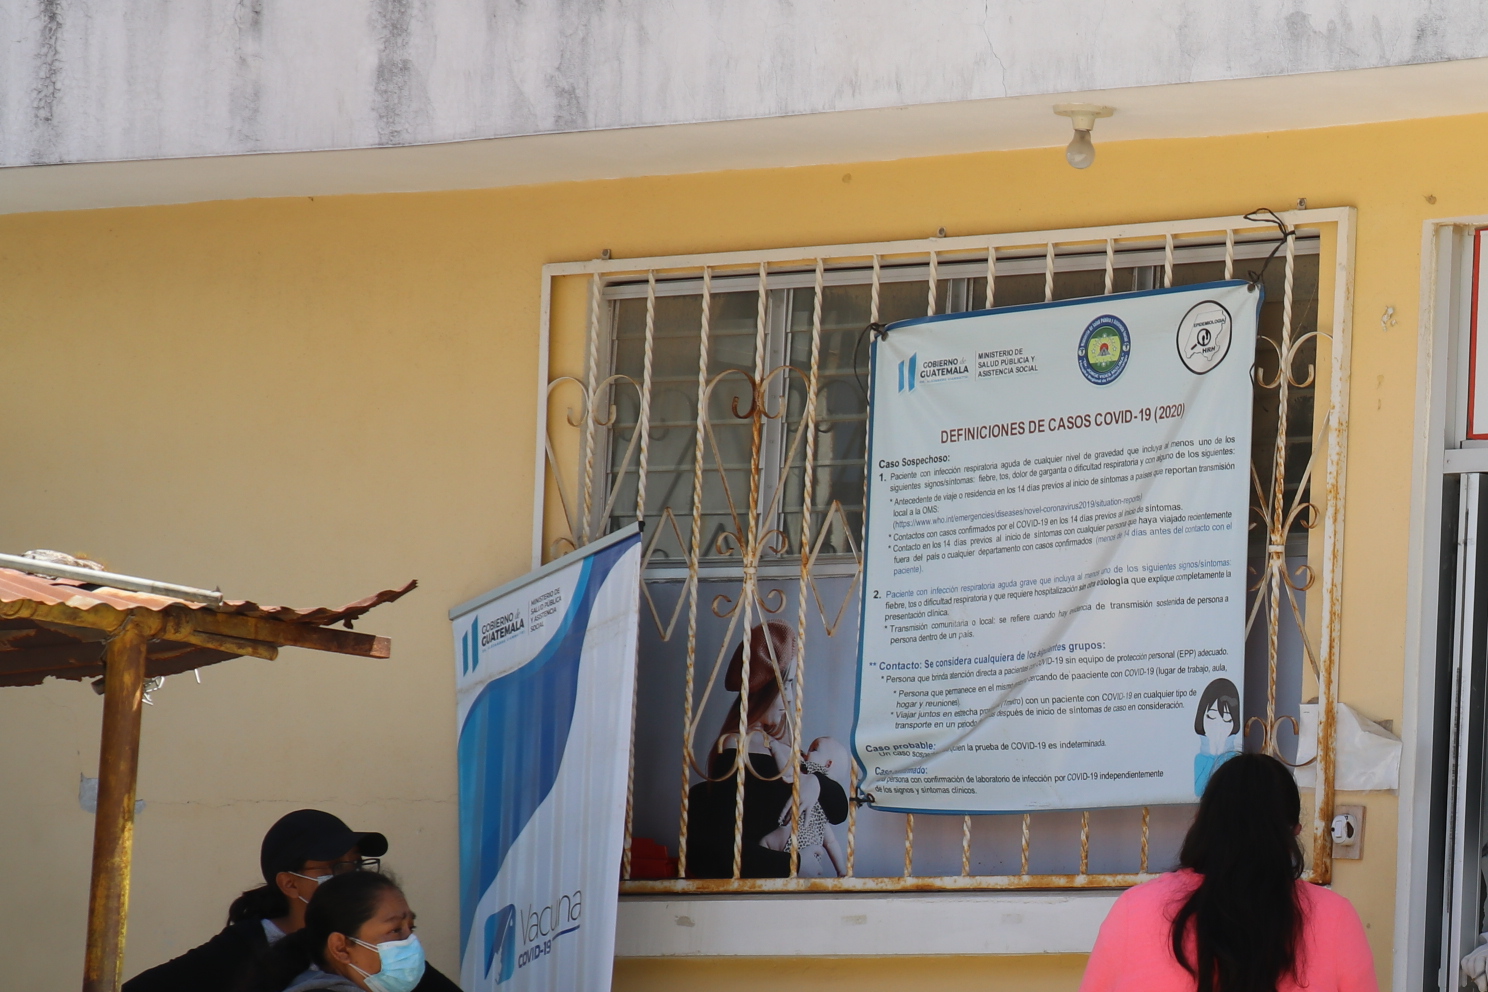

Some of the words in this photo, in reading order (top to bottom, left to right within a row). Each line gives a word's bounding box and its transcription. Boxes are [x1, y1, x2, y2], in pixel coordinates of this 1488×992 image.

[978, 349, 1013, 359] MINISTERIO
[1014, 347, 1022, 355] DE
[920, 366, 968, 378] GUATEMALA
[923, 358, 958, 368] GOBIERNO
[978, 367, 1013, 377] ASISTENCIA
[1015, 364, 1037, 373] SOCIAL
[941, 421, 1025, 443] DEFINICIONES
[1028, 419, 1044, 433] DE
[1048, 414, 1091, 431] CASOS
[1094, 407, 1151, 426] COVID-19
[1154, 403, 1184, 422] (2020)
[879, 459, 899, 468] Caso
[902, 455, 950, 466] Sospechoso:
[879, 472, 886, 481] 1.
[890, 471, 917, 480] Paciente
[933, 466, 960, 475] infección
[963, 463, 997, 472] respiratoria
[1000, 460, 1020, 470] aguda
[1023, 458, 1031, 466] de
[1034, 456, 1062, 464] cualquier
[1065, 452, 1080, 461] nivel
[1083, 451, 1091, 459] de
[1094, 448, 1123, 460] gravedad
[1127, 447, 1139, 456] que
[482, 612, 513, 634] GOBIERNO
[482, 618, 524, 646] GUATEMALA
[879, 661, 921, 670] Contacto:
[924, 659, 933, 668] Se
[935, 657, 971, 667] considera
[973, 654, 1014, 664] cualquiera
[1016, 651, 1025, 660] de
[865, 744, 890, 752] Caso
[893, 742, 936, 750] probable:
[520, 890, 581, 945] Vacuna
[518, 939, 551, 968] COVID-19
